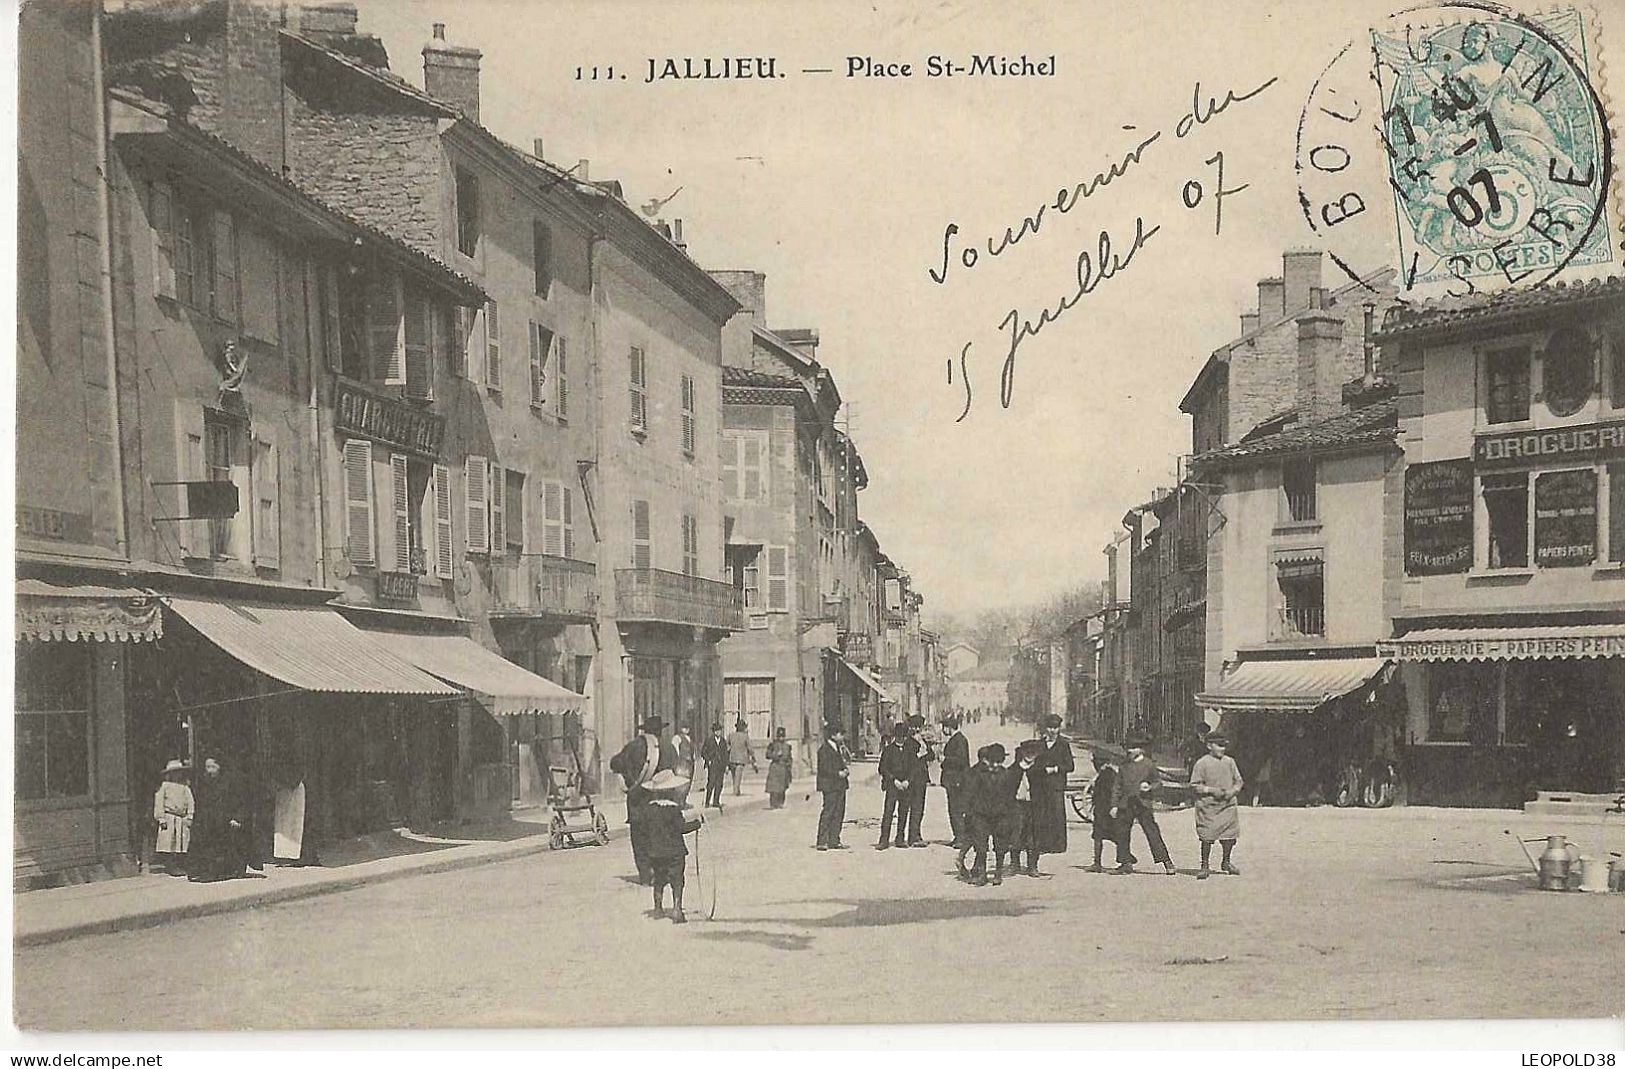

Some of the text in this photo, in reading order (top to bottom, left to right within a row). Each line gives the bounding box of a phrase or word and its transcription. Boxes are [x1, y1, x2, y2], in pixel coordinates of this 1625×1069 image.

[928, 76, 1279, 284] Souvenir du
[1446, 168, 1502, 228] 07
[997, 216, 1161, 409] Juillet
[1182, 150, 1250, 236] 07
[1401, 642, 1484, 658] DROGUERIE
[1507, 639, 1577, 655] PAPIERS
